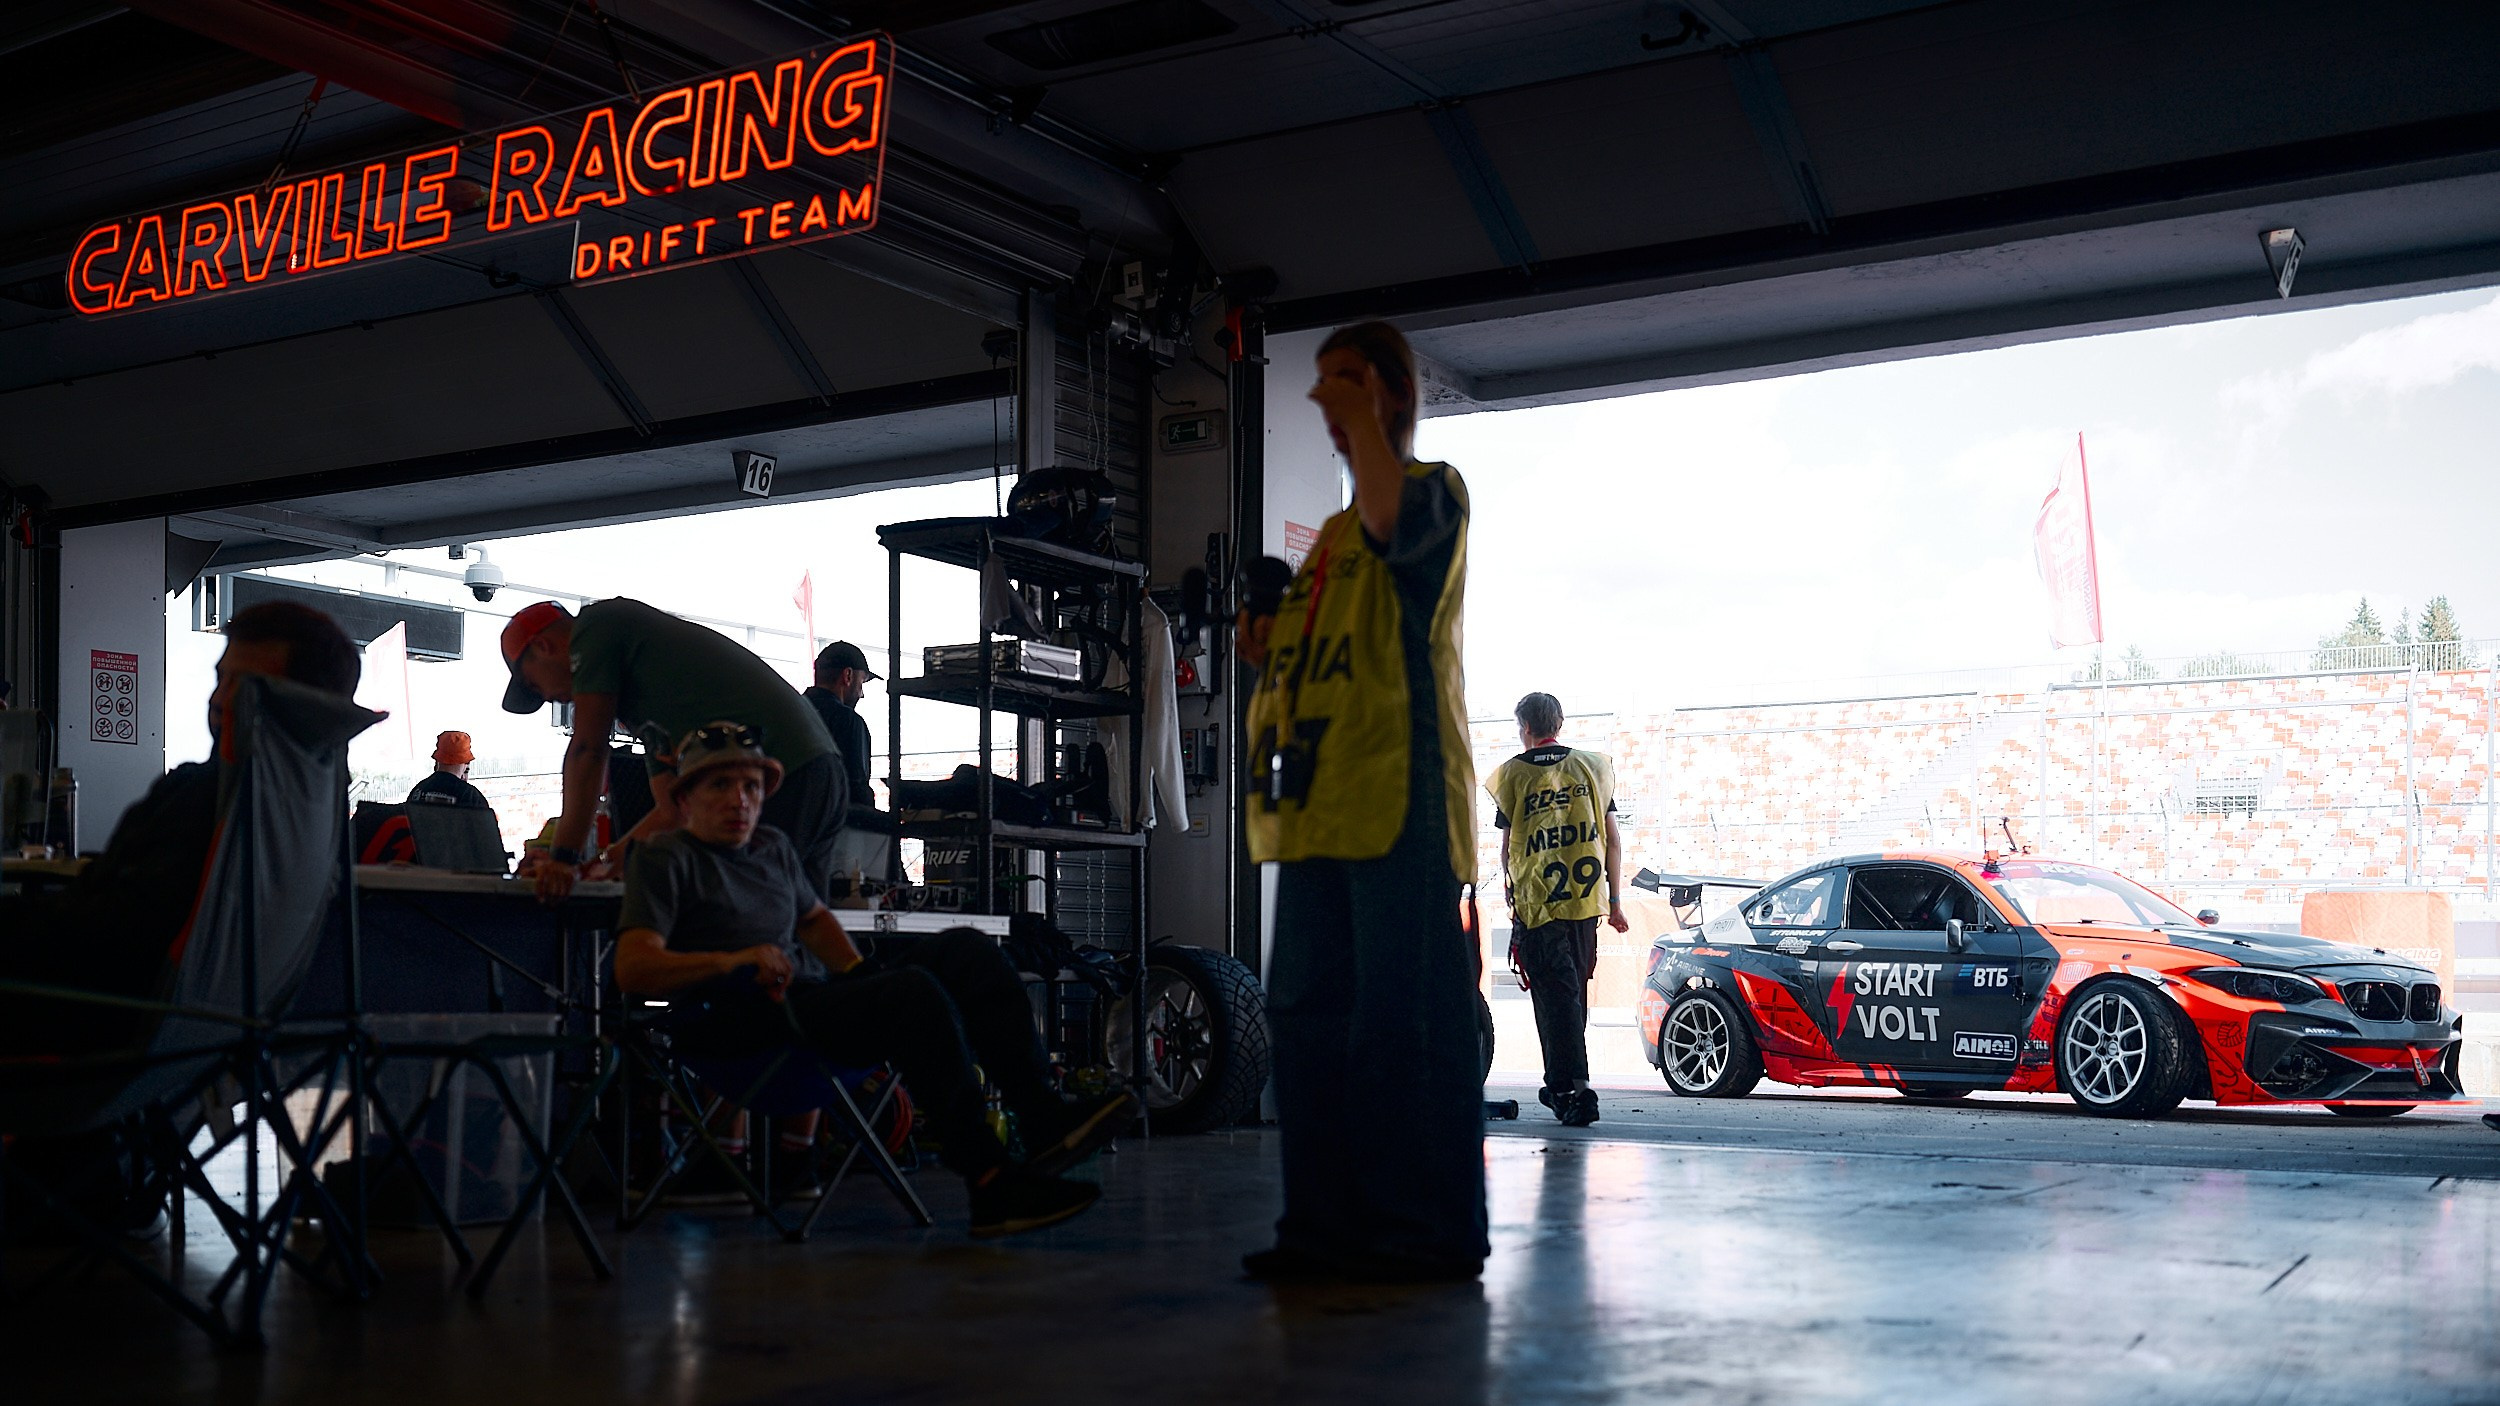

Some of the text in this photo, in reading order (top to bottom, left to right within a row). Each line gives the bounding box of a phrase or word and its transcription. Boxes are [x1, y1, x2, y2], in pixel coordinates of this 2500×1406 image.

[67, 38, 885, 315] CARVILLE RACING
[575, 183, 874, 280] DRIFT TEAM
[749, 459, 772, 491] 16
[92, 657, 137, 666] ПОВЫШЕННОЙ
[96, 663, 134, 671] ОПАСНОСТИ
[1523, 785, 1572, 817] RDS
[1525, 821, 1598, 858] MEDIA
[1541, 855, 1602, 905] 29
[1676, 961, 1706, 976] AIRLINE
[1854, 961, 1943, 997] START
[1973, 967, 2009, 988] ВТБ
[1855, 1004, 1941, 1042] VOLT
[1956, 1037, 2014, 1055] AIMOL
